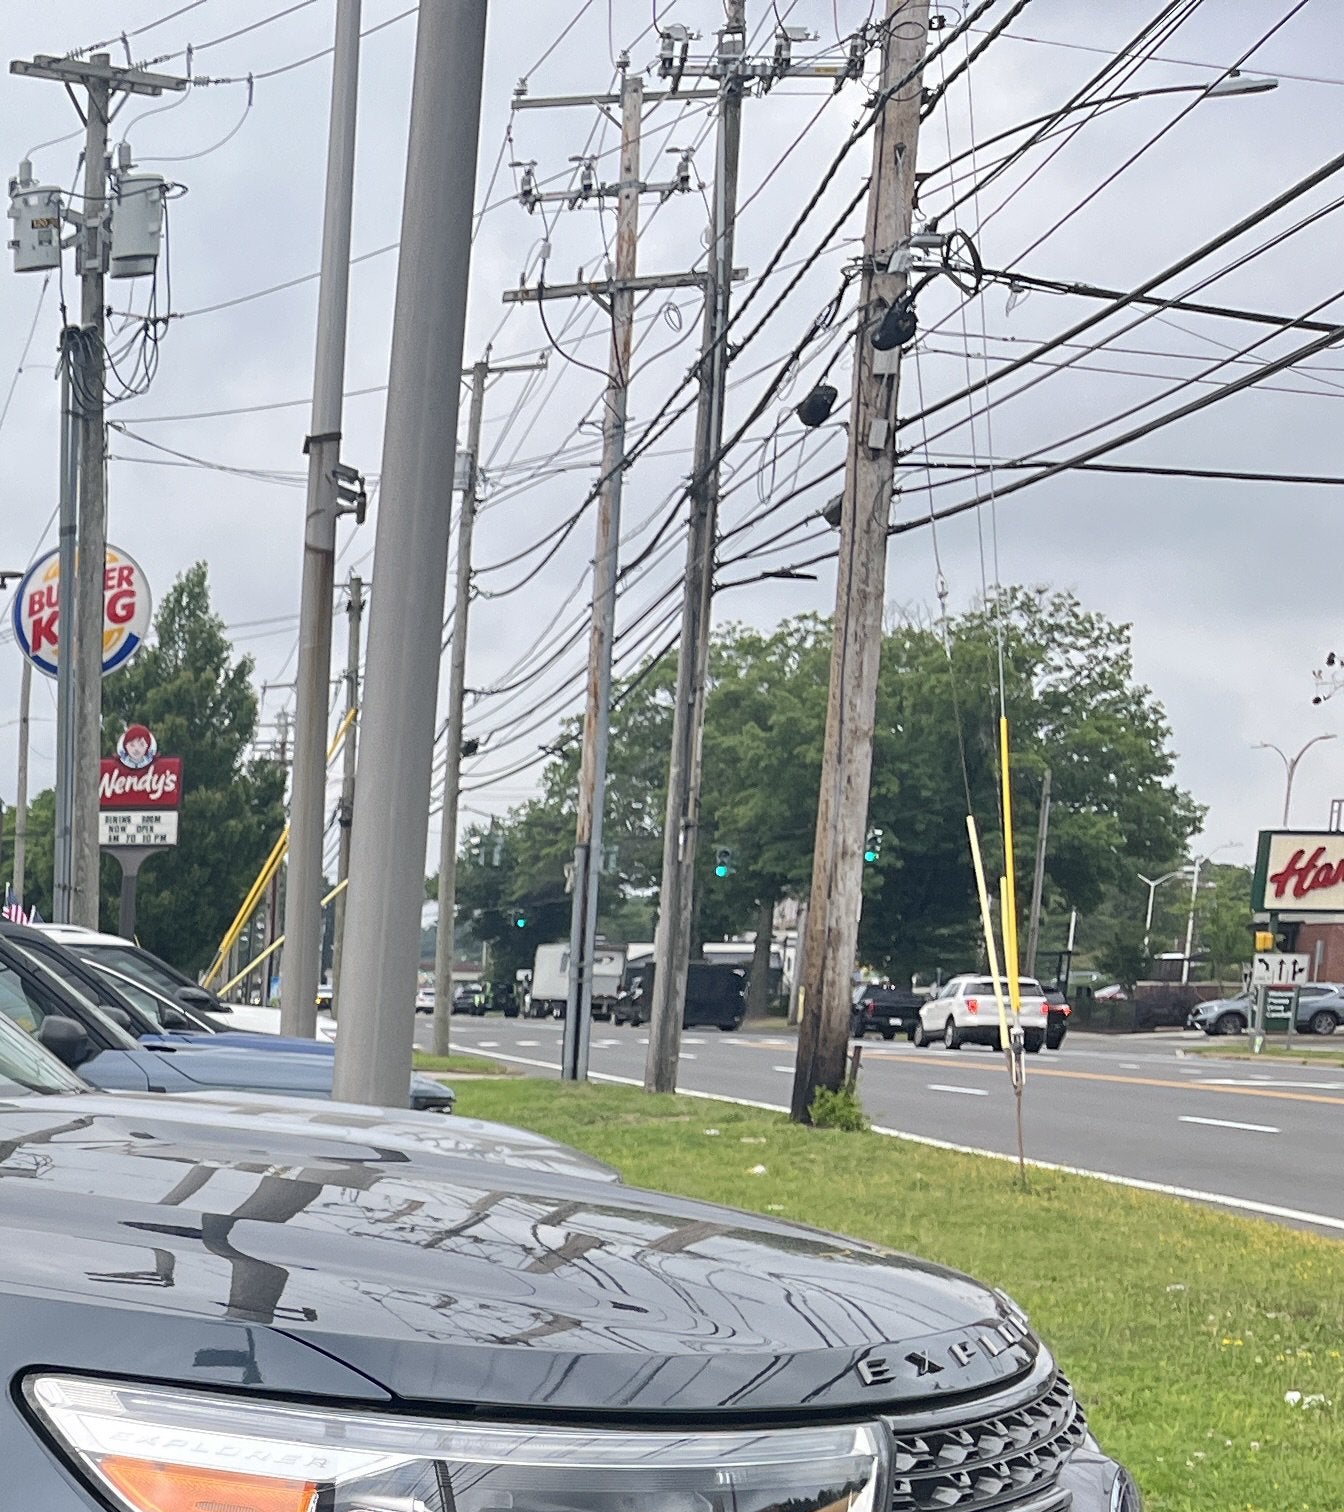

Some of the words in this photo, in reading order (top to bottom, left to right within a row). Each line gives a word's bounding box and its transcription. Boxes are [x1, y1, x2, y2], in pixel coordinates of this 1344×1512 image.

[28, 565, 135, 618] BUER
[31, 589, 137, 653] KG
[108, 1431, 330, 1470] EXPLORER
